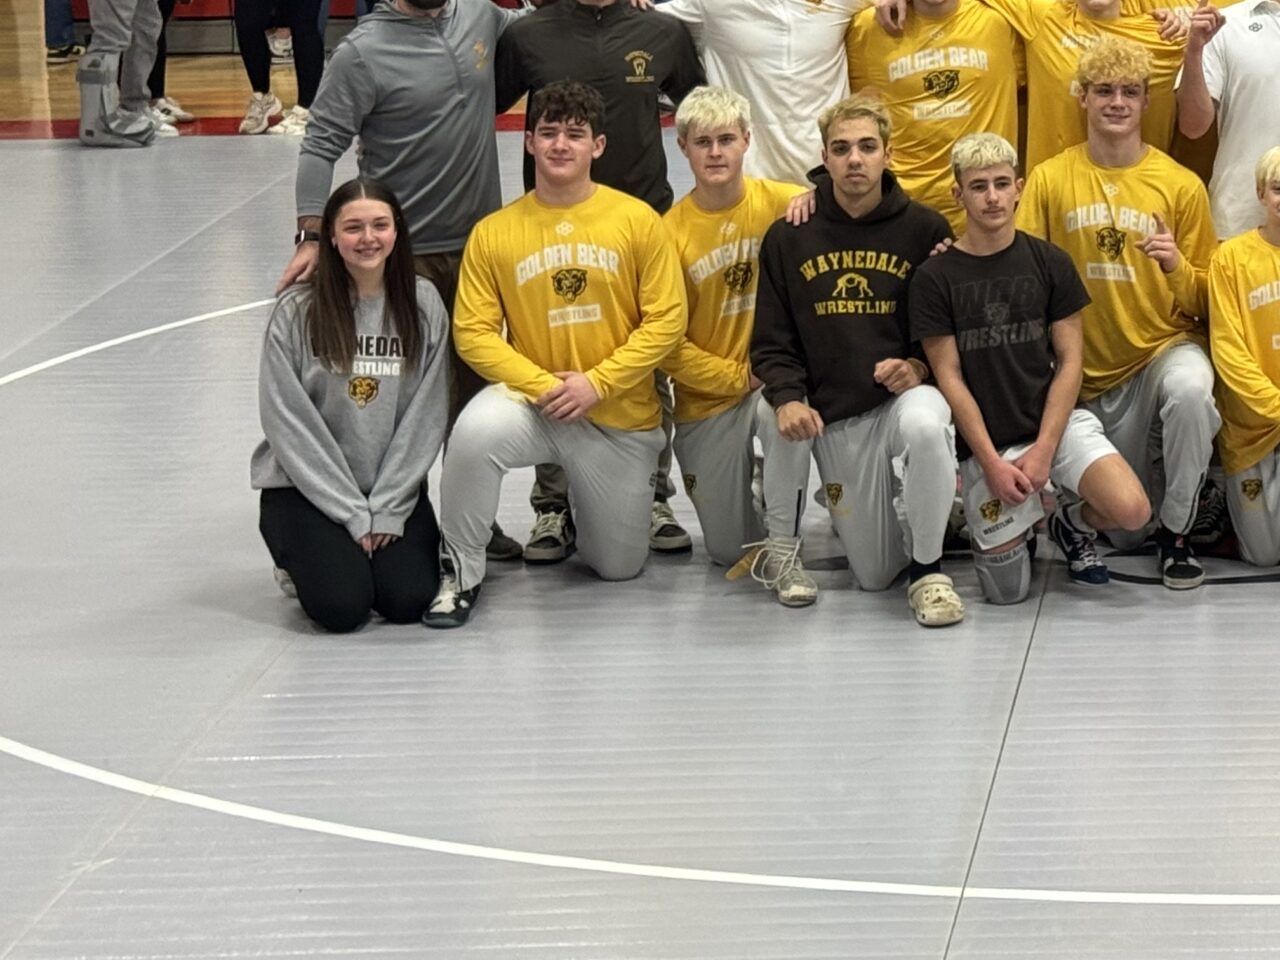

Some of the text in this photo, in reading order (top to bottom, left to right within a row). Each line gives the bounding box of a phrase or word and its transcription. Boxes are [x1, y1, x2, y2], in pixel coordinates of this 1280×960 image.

[889, 46, 988, 82] GOLDEN BEAR
[515, 243, 572, 286] GOLDEN
[800, 250, 912, 281] WAYNEDALE
